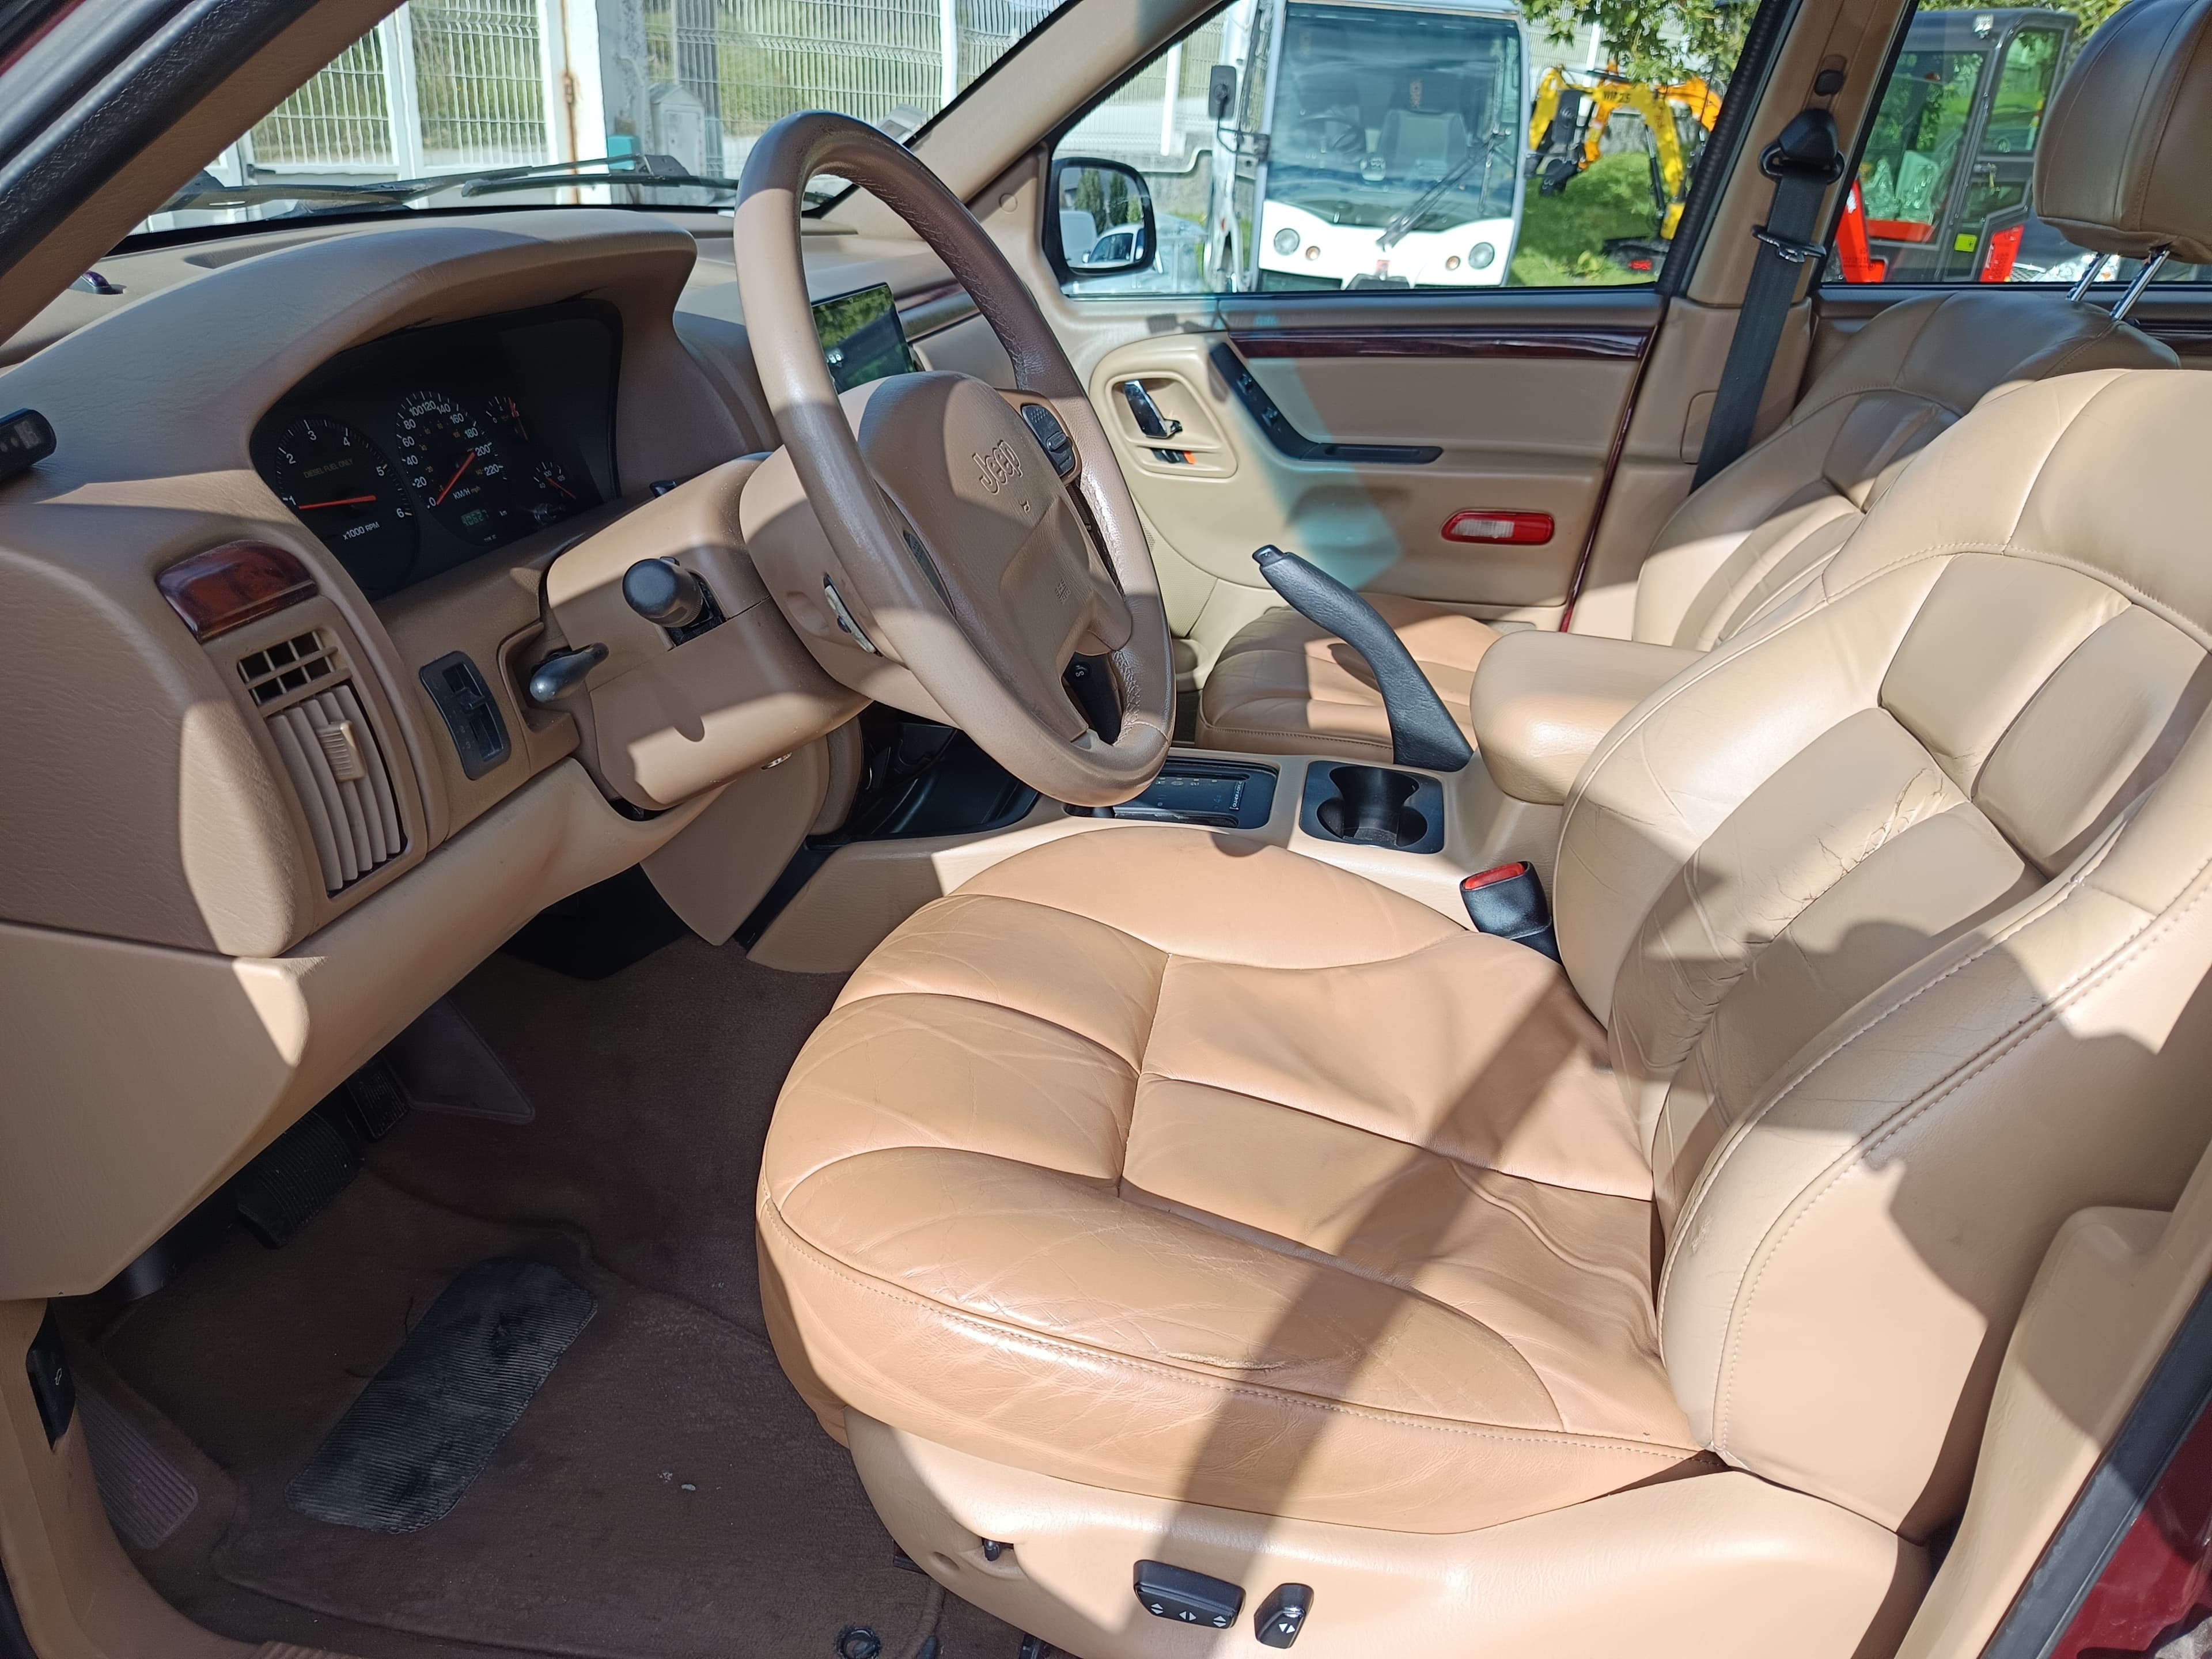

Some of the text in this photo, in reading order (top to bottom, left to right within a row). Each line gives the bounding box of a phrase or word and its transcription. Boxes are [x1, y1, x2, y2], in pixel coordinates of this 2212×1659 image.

[409, 406, 425, 416] 100
[422, 400, 437, 411] 120
[437, 403, 451, 415] 140
[450, 413, 464, 424] 160
[403, 419, 416, 430] 80
[307, 430, 317, 441] 3
[464, 427, 478, 438] 180
[342, 437, 351, 447] 4
[402, 436, 415, 447] 60
[475, 445, 491, 457] 200
[286, 453, 297, 465] 2
[406, 455, 419, 465] 40
[303, 458, 354, 479] DIESEL FUEL ONLY
[376, 466, 385, 476] 5
[484, 464, 499, 476] 220
[972, 440, 1023, 495] Jeep
[414, 476, 427, 488] 20
[453, 488, 471, 500] KM/H
[287, 495, 297, 506] 1
[429, 497, 437, 507] 0
[396, 508, 405, 518] 6
[365, 521, 381, 532] RPM
